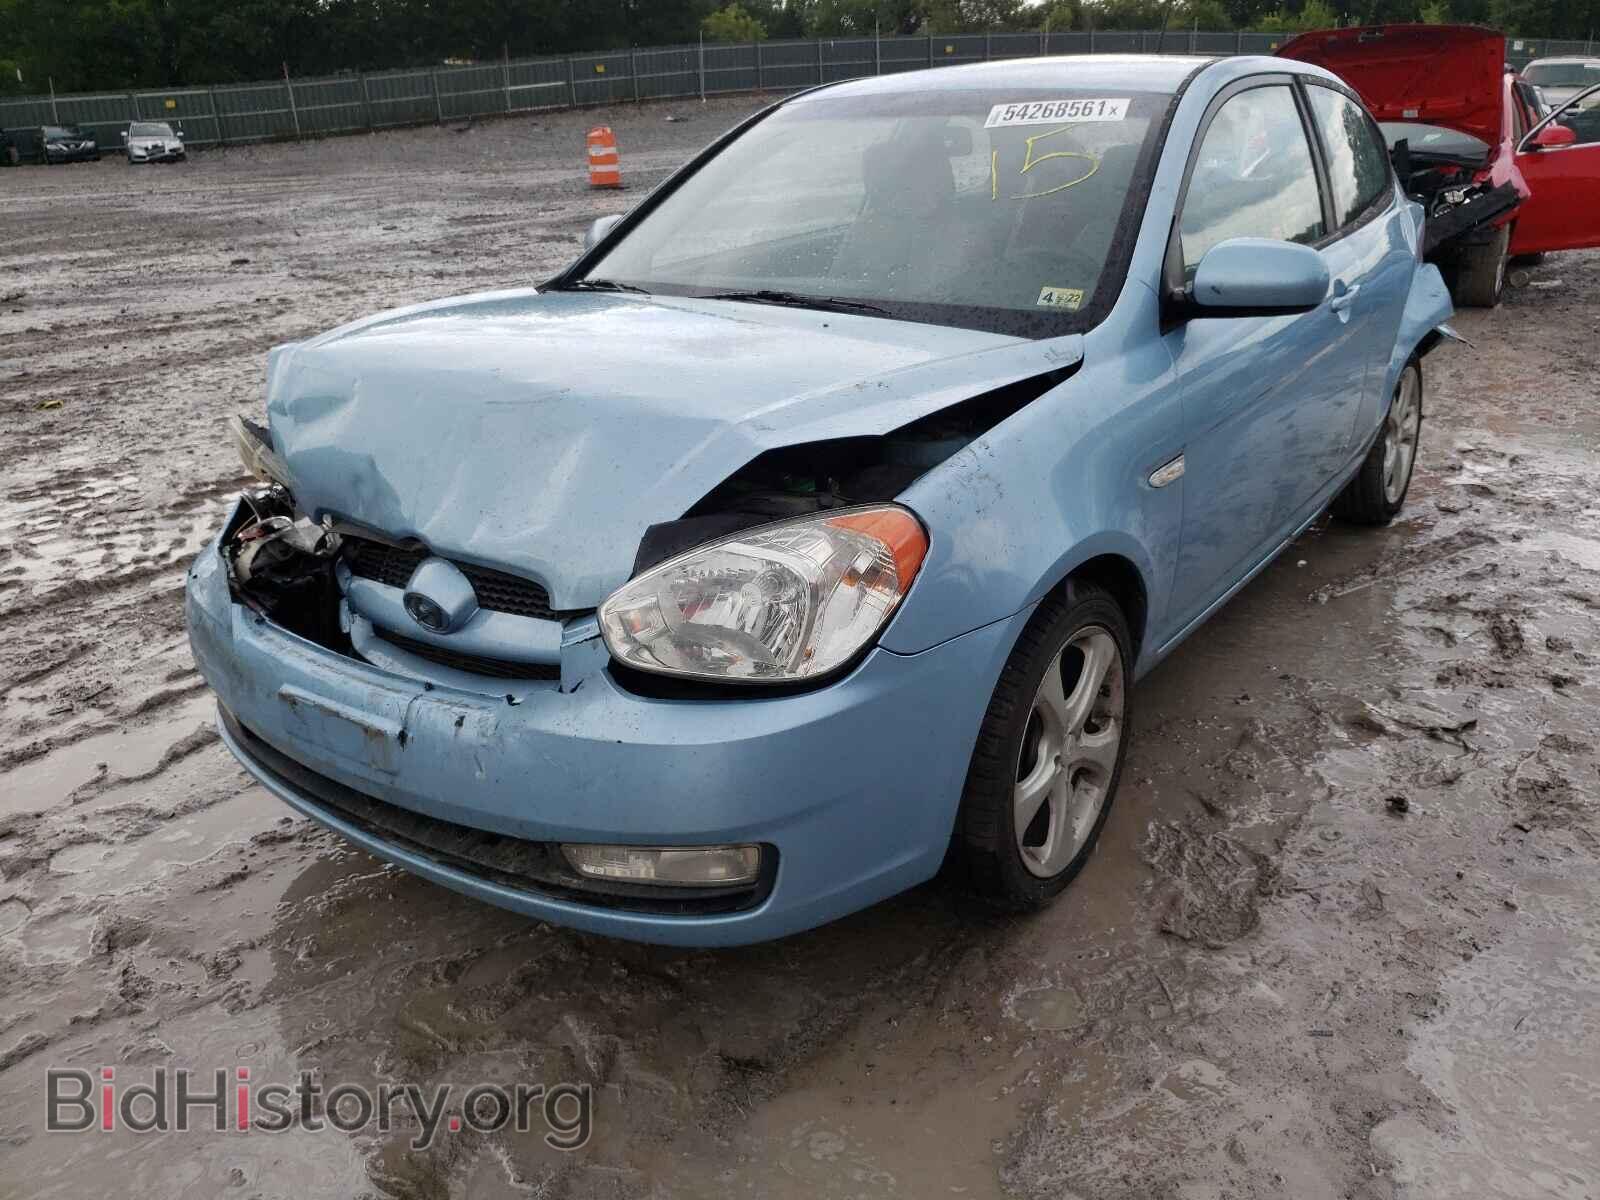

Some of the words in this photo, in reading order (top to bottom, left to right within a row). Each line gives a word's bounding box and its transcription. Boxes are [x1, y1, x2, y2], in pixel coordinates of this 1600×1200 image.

[1002, 100, 1107, 121] 54268561
[991, 122, 1102, 200] 15
[1042, 292, 1054, 303] 4
